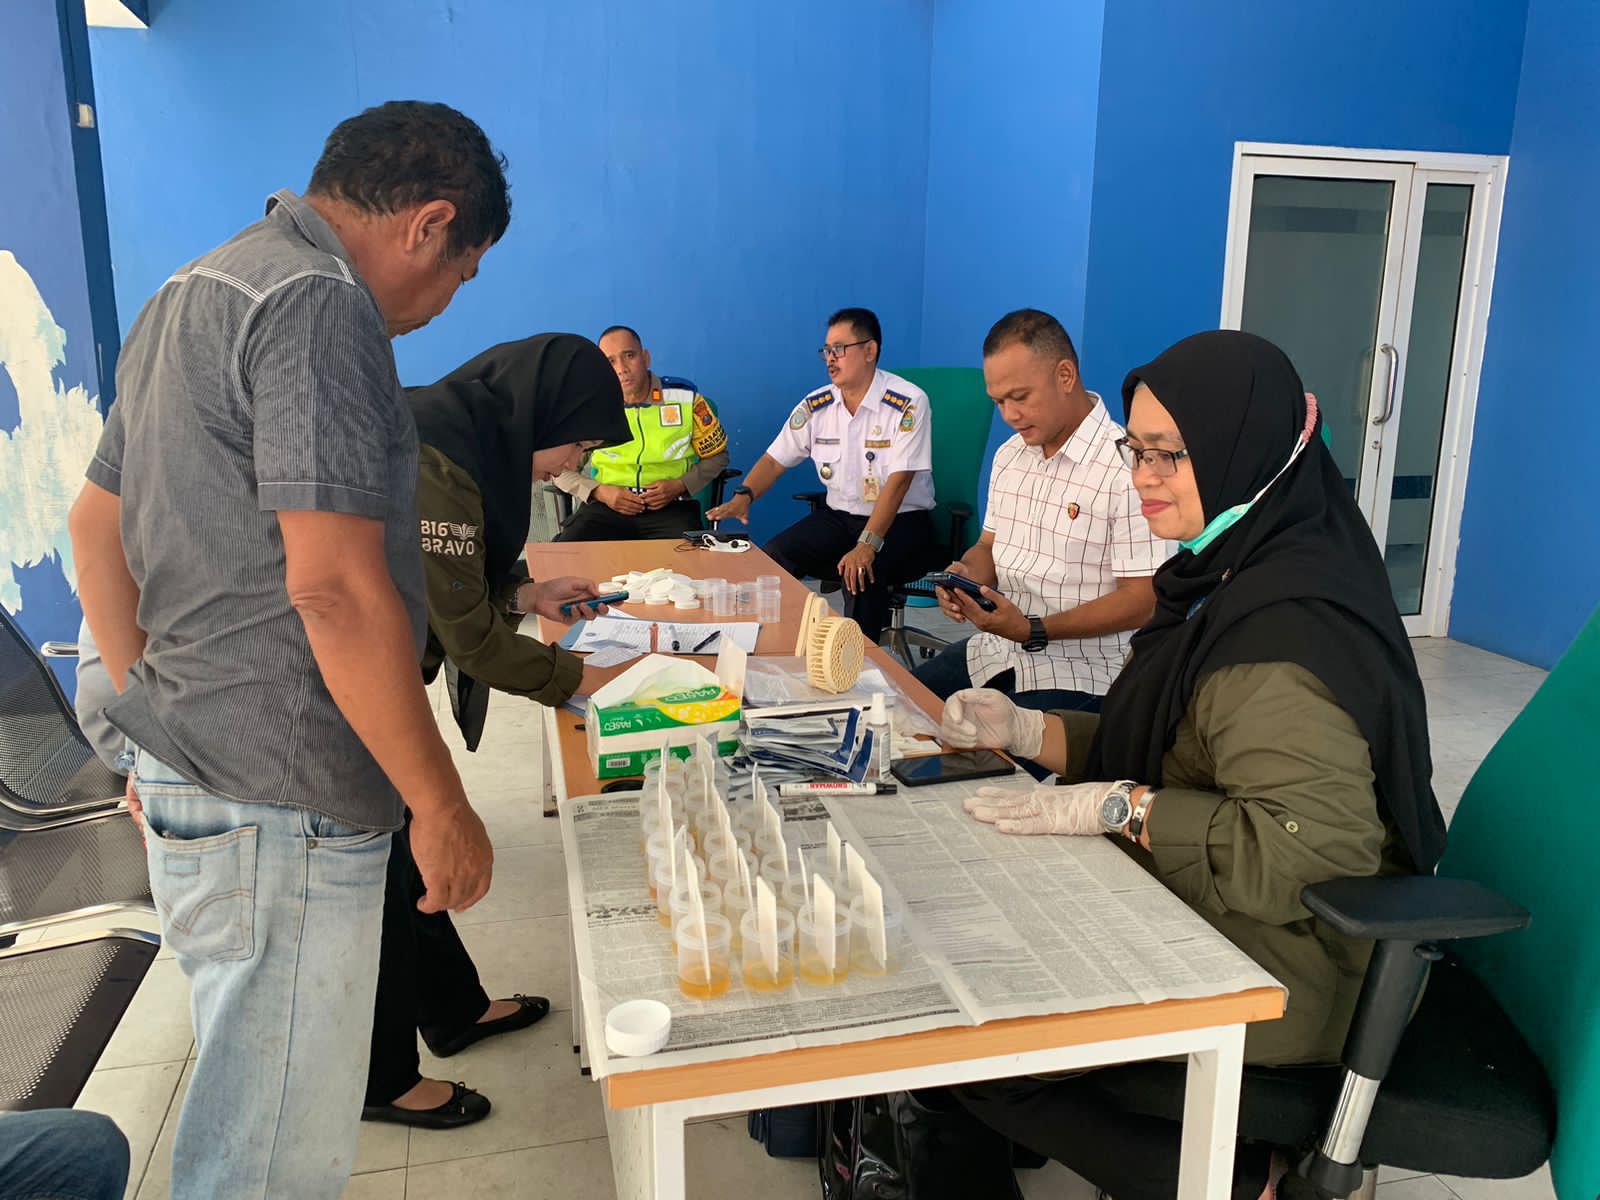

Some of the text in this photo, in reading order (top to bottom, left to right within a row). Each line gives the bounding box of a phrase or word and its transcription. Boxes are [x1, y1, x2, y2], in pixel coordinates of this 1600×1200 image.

[422, 537, 475, 556] BRAVO
[664, 688, 716, 702] PASEO
[604, 719, 632, 732] PASEO
